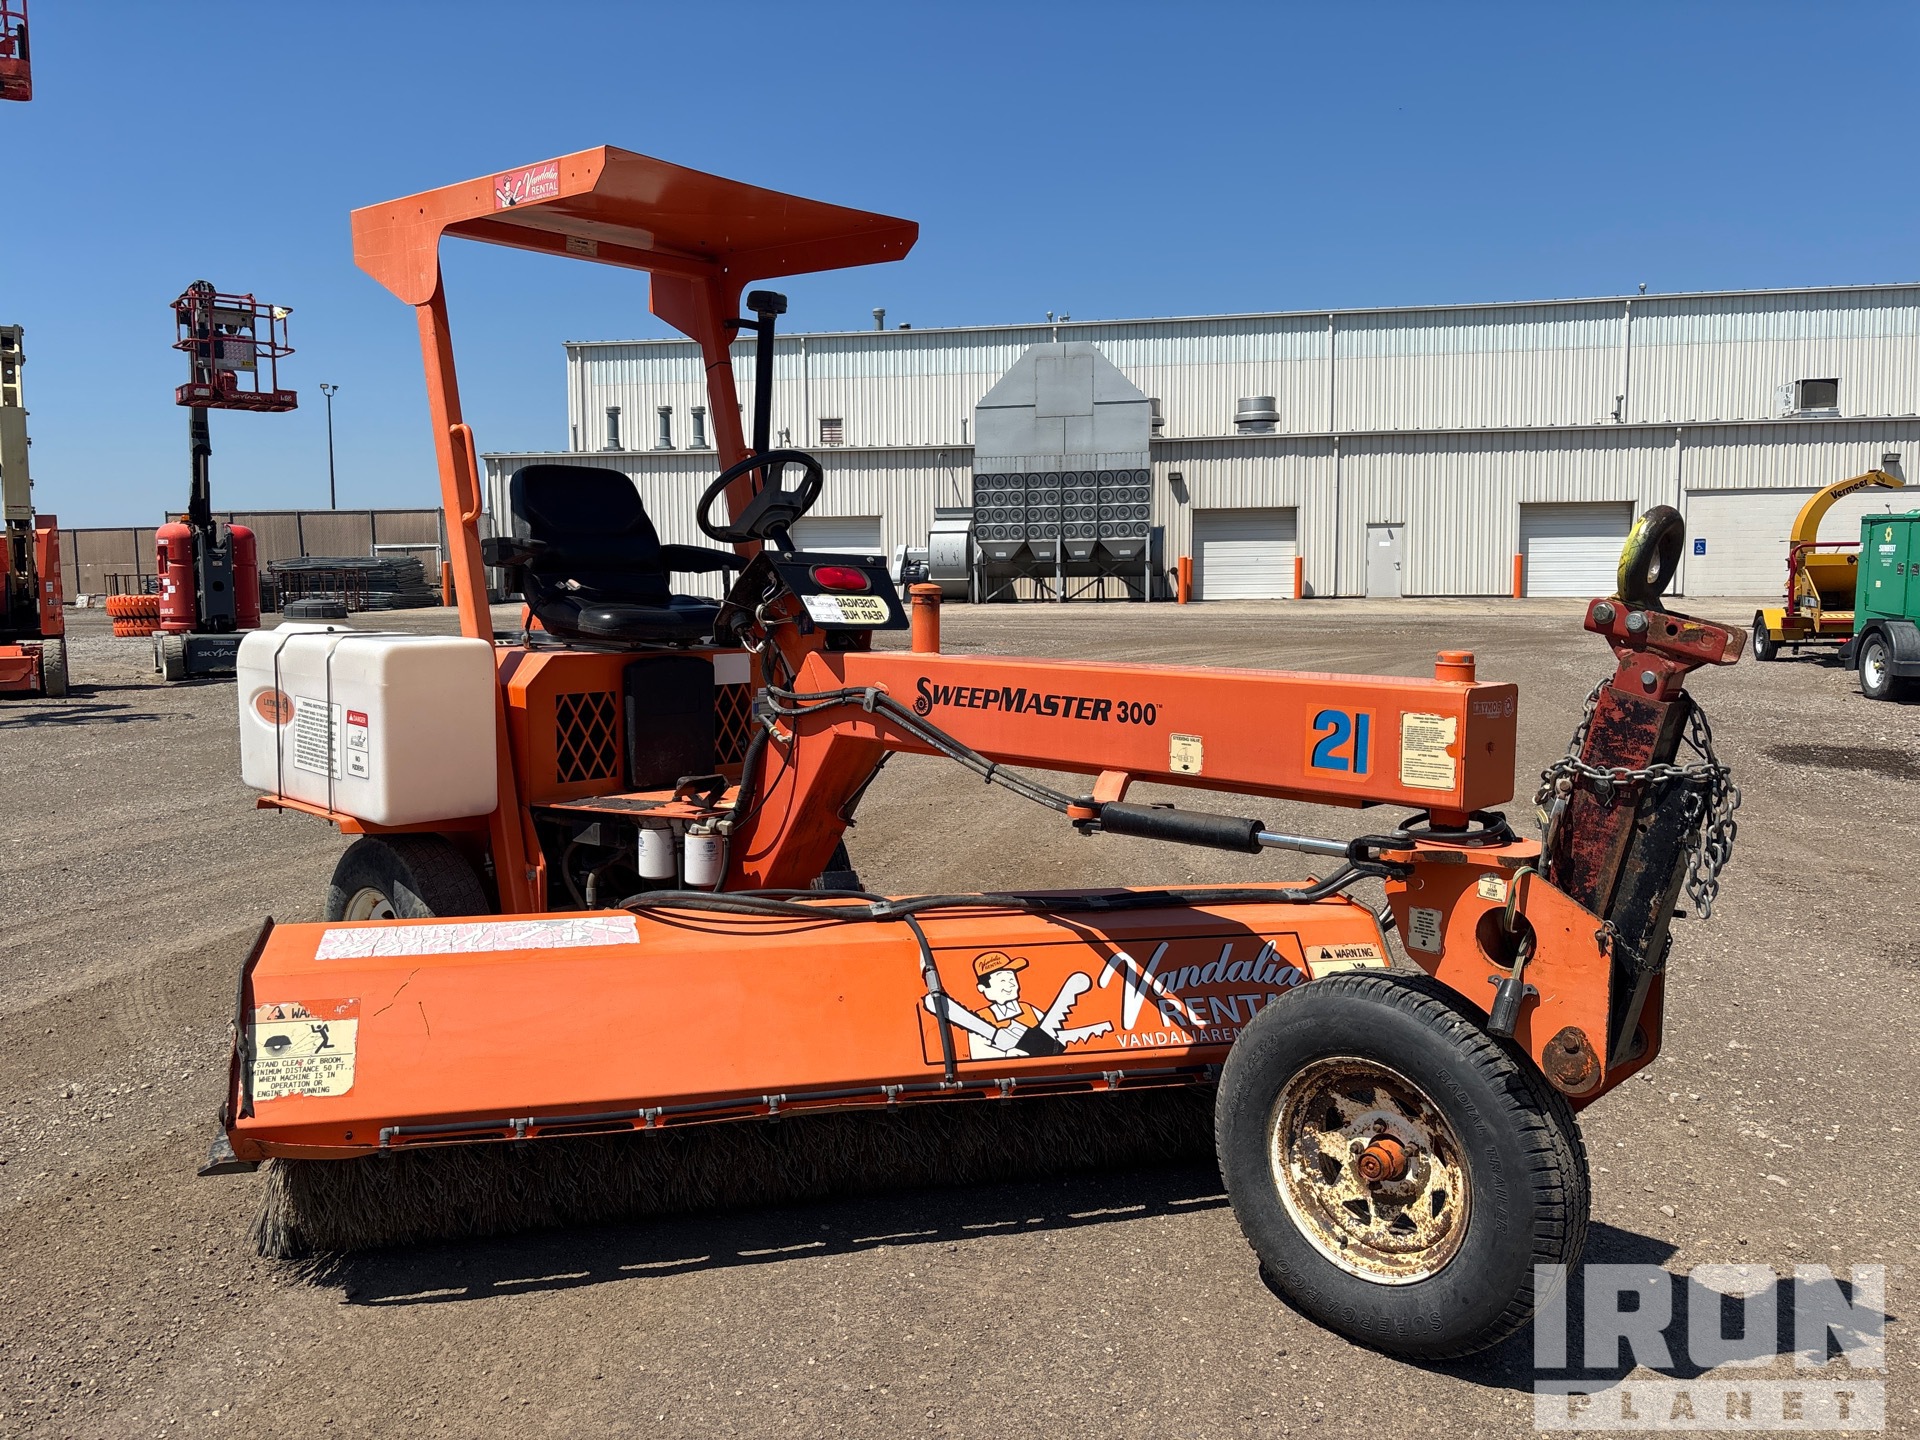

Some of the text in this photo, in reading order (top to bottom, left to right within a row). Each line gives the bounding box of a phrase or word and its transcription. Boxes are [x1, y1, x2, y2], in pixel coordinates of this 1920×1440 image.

[532, 182, 558, 196] RENTAL
[1830, 479, 1869, 500] Vermeer
[1311, 709, 1370, 775] 21
[1334, 947, 1374, 959] WARNING
[1097, 941, 1304, 1030] Vandalia
[256, 1060, 279, 1069] STAND
[306, 1058, 316, 1066] OF
[258, 1070, 336, 1083] WHEN MACHINE IS IN
[285, 1066, 319, 1076] DISTANCE
[270, 1079, 323, 1090] OPERATION OR
[256, 1089, 283, 1098] ENGINE
[1436, 1068, 1509, 1236] RADIAL TRAILER
